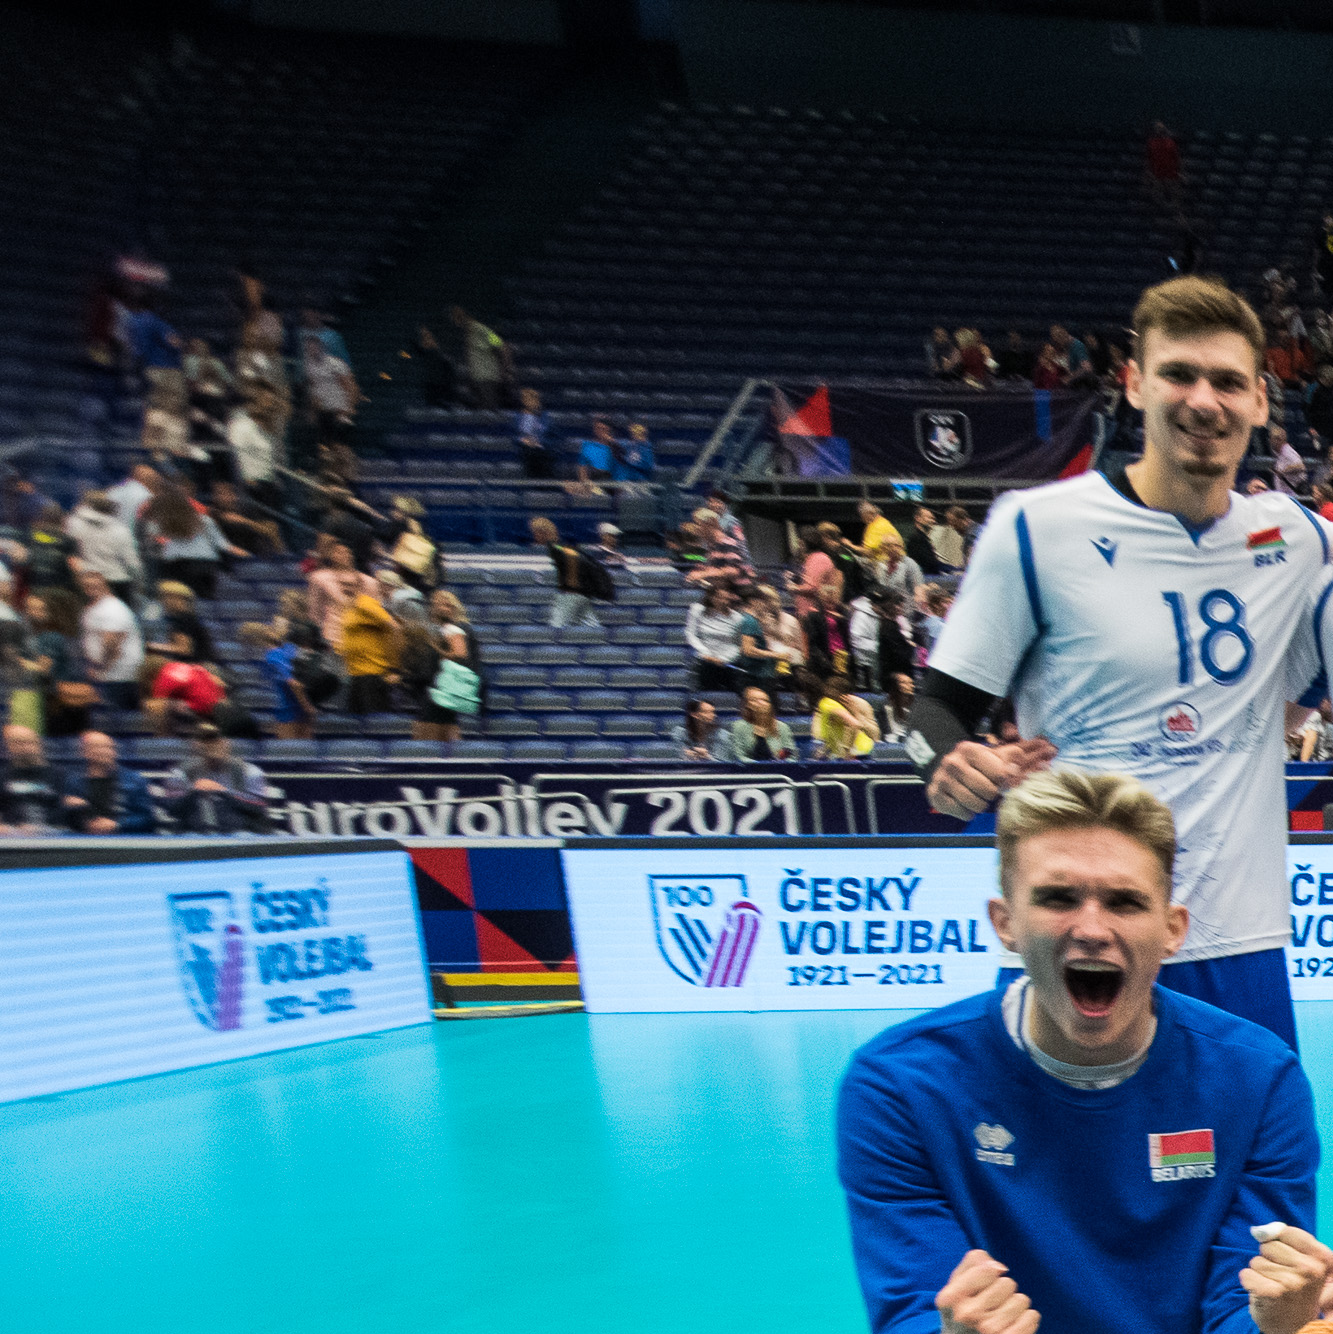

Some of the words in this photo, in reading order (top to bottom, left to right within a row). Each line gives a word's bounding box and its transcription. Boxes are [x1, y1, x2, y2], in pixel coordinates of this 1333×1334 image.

[1254, 551, 1286, 568] BLR
[1162, 588, 1255, 686] 18
[648, 790, 798, 836] 2021
[779, 868, 922, 912] ČESKÝ
[779, 919, 988, 955] VOLEJBAL
